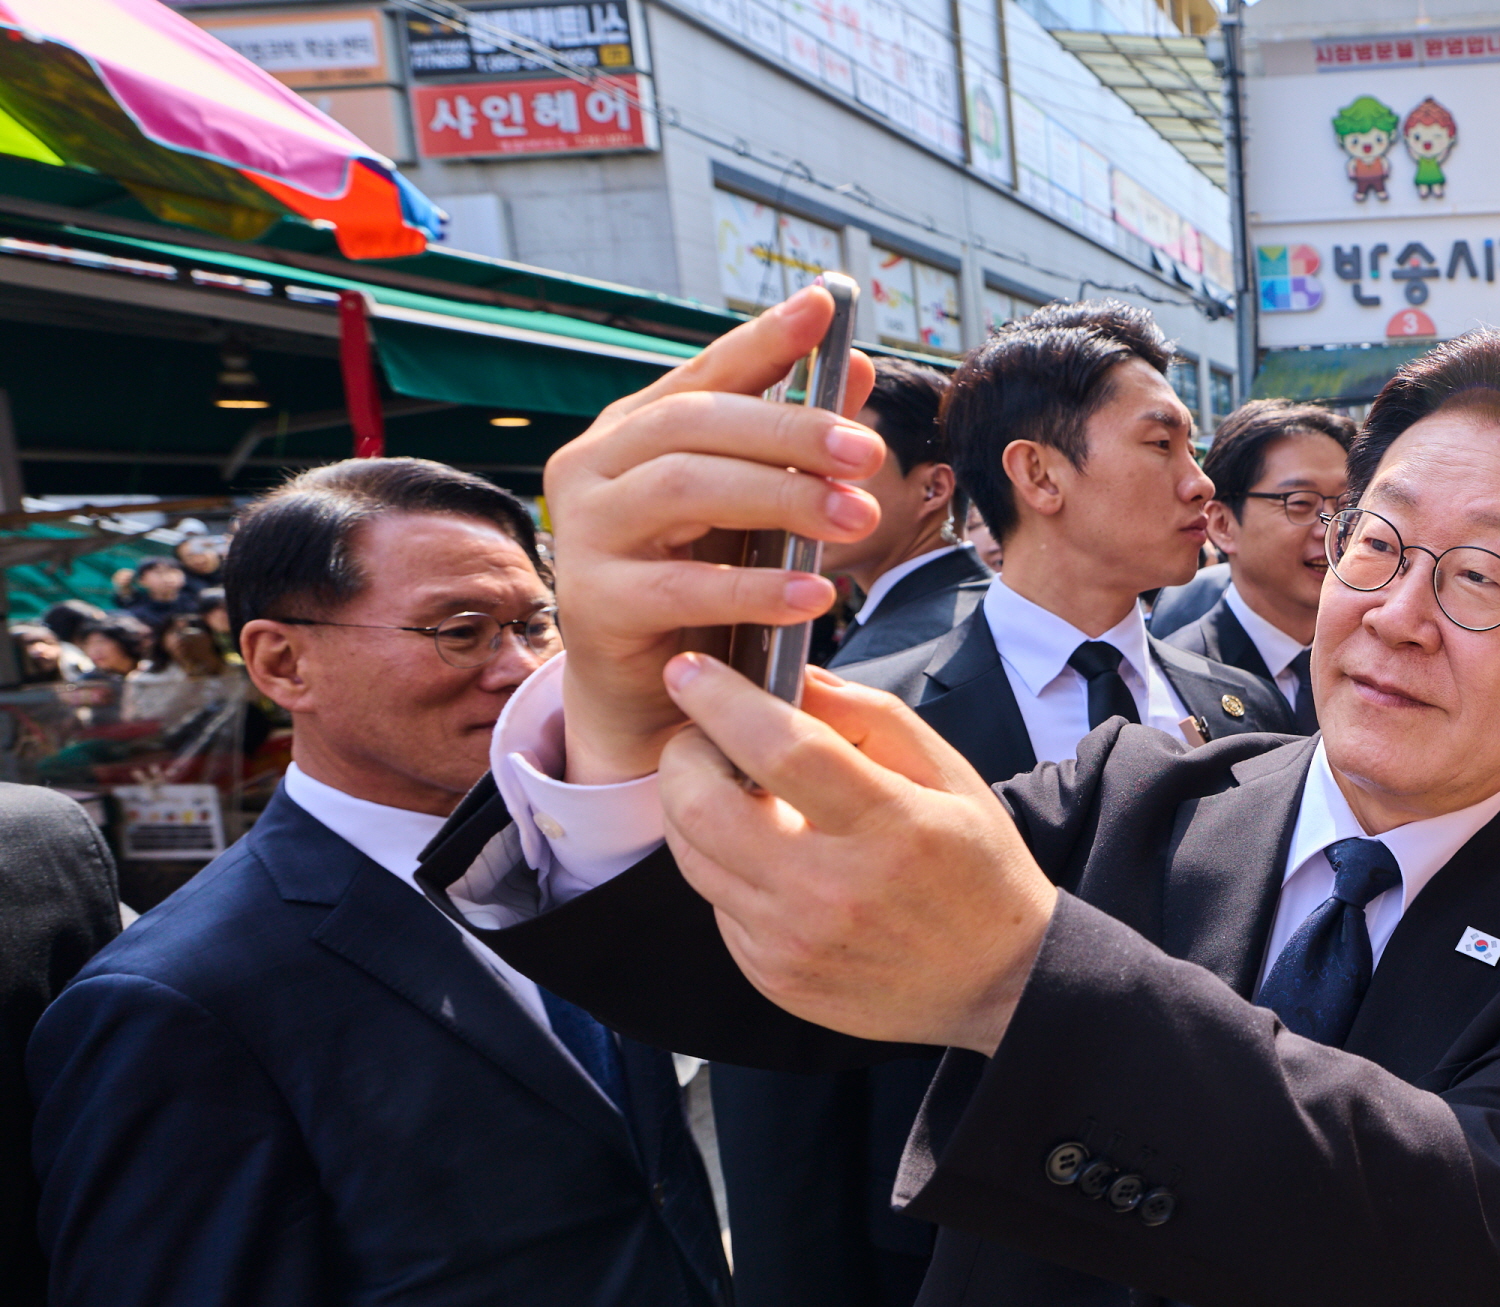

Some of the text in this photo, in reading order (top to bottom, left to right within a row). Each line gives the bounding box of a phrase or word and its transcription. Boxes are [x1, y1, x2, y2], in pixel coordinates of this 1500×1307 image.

[1315, 39, 1414, 65] 시장방문을
[429, 87, 633, 140] 샤인헤어
[1402, 312, 1420, 336] 3
